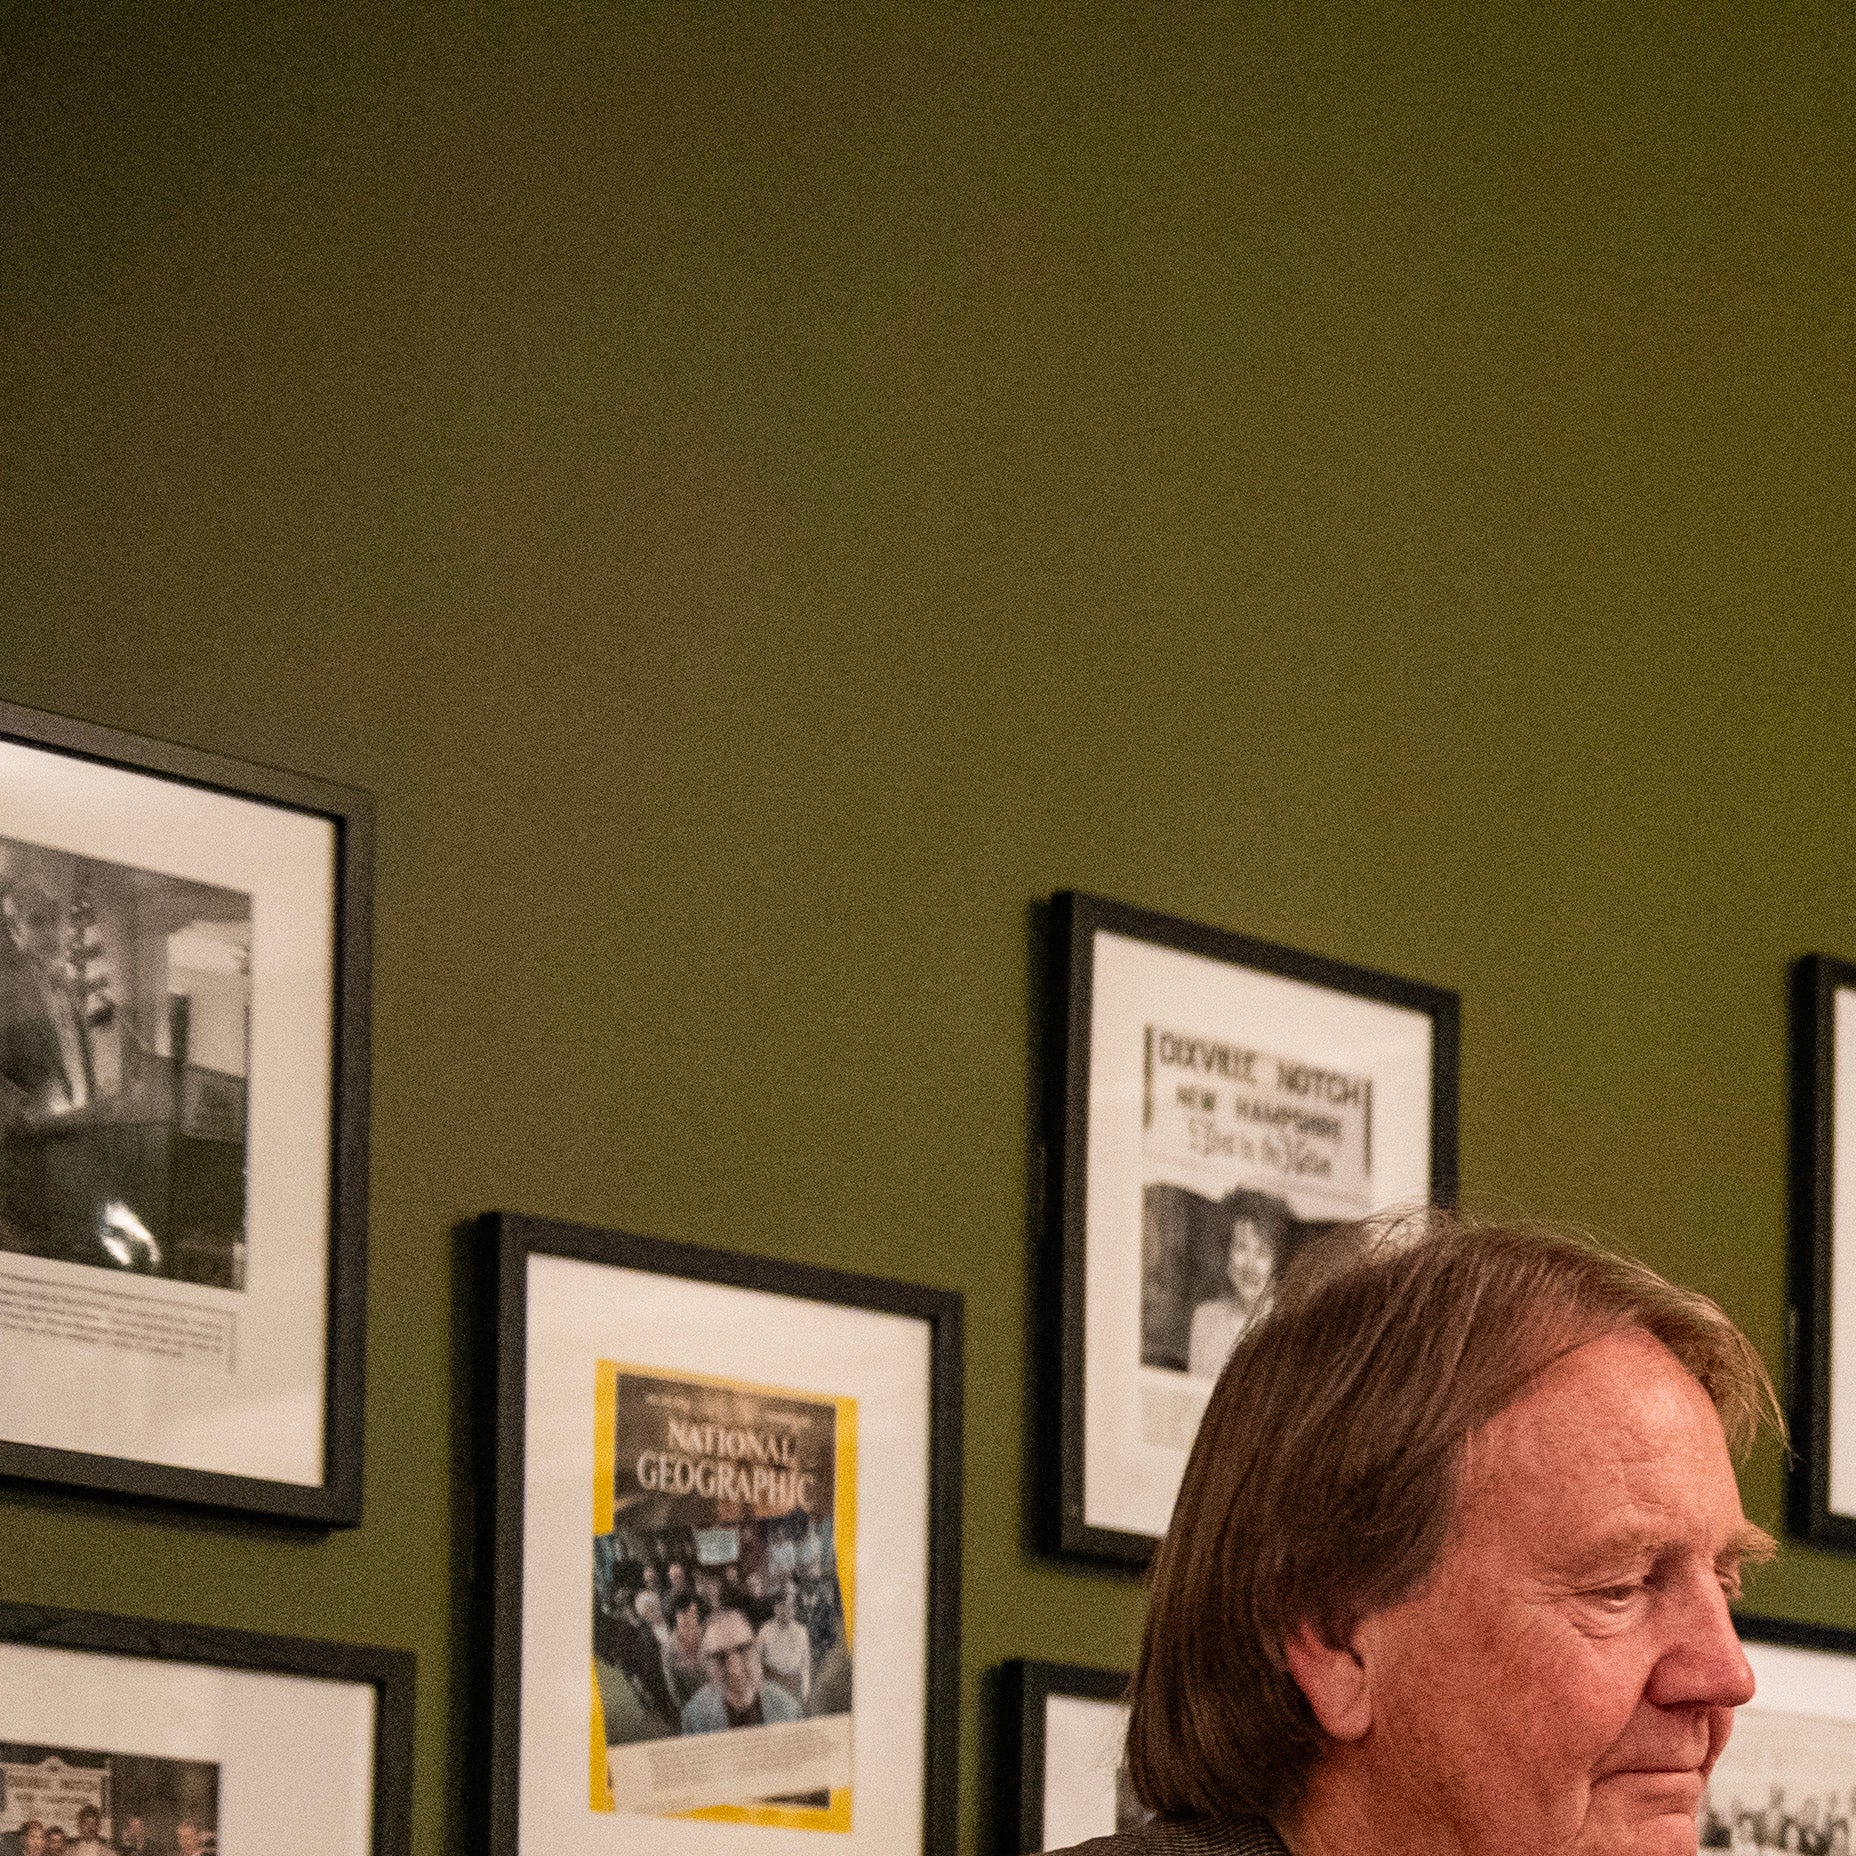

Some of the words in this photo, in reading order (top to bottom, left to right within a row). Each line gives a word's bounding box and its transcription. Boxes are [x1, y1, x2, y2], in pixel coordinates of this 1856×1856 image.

[1276, 1058, 1361, 1107] NOTCH
[667, 1416, 798, 1464] NATIONAL
[636, 1449, 816, 1510] GEOGRAPHIC
